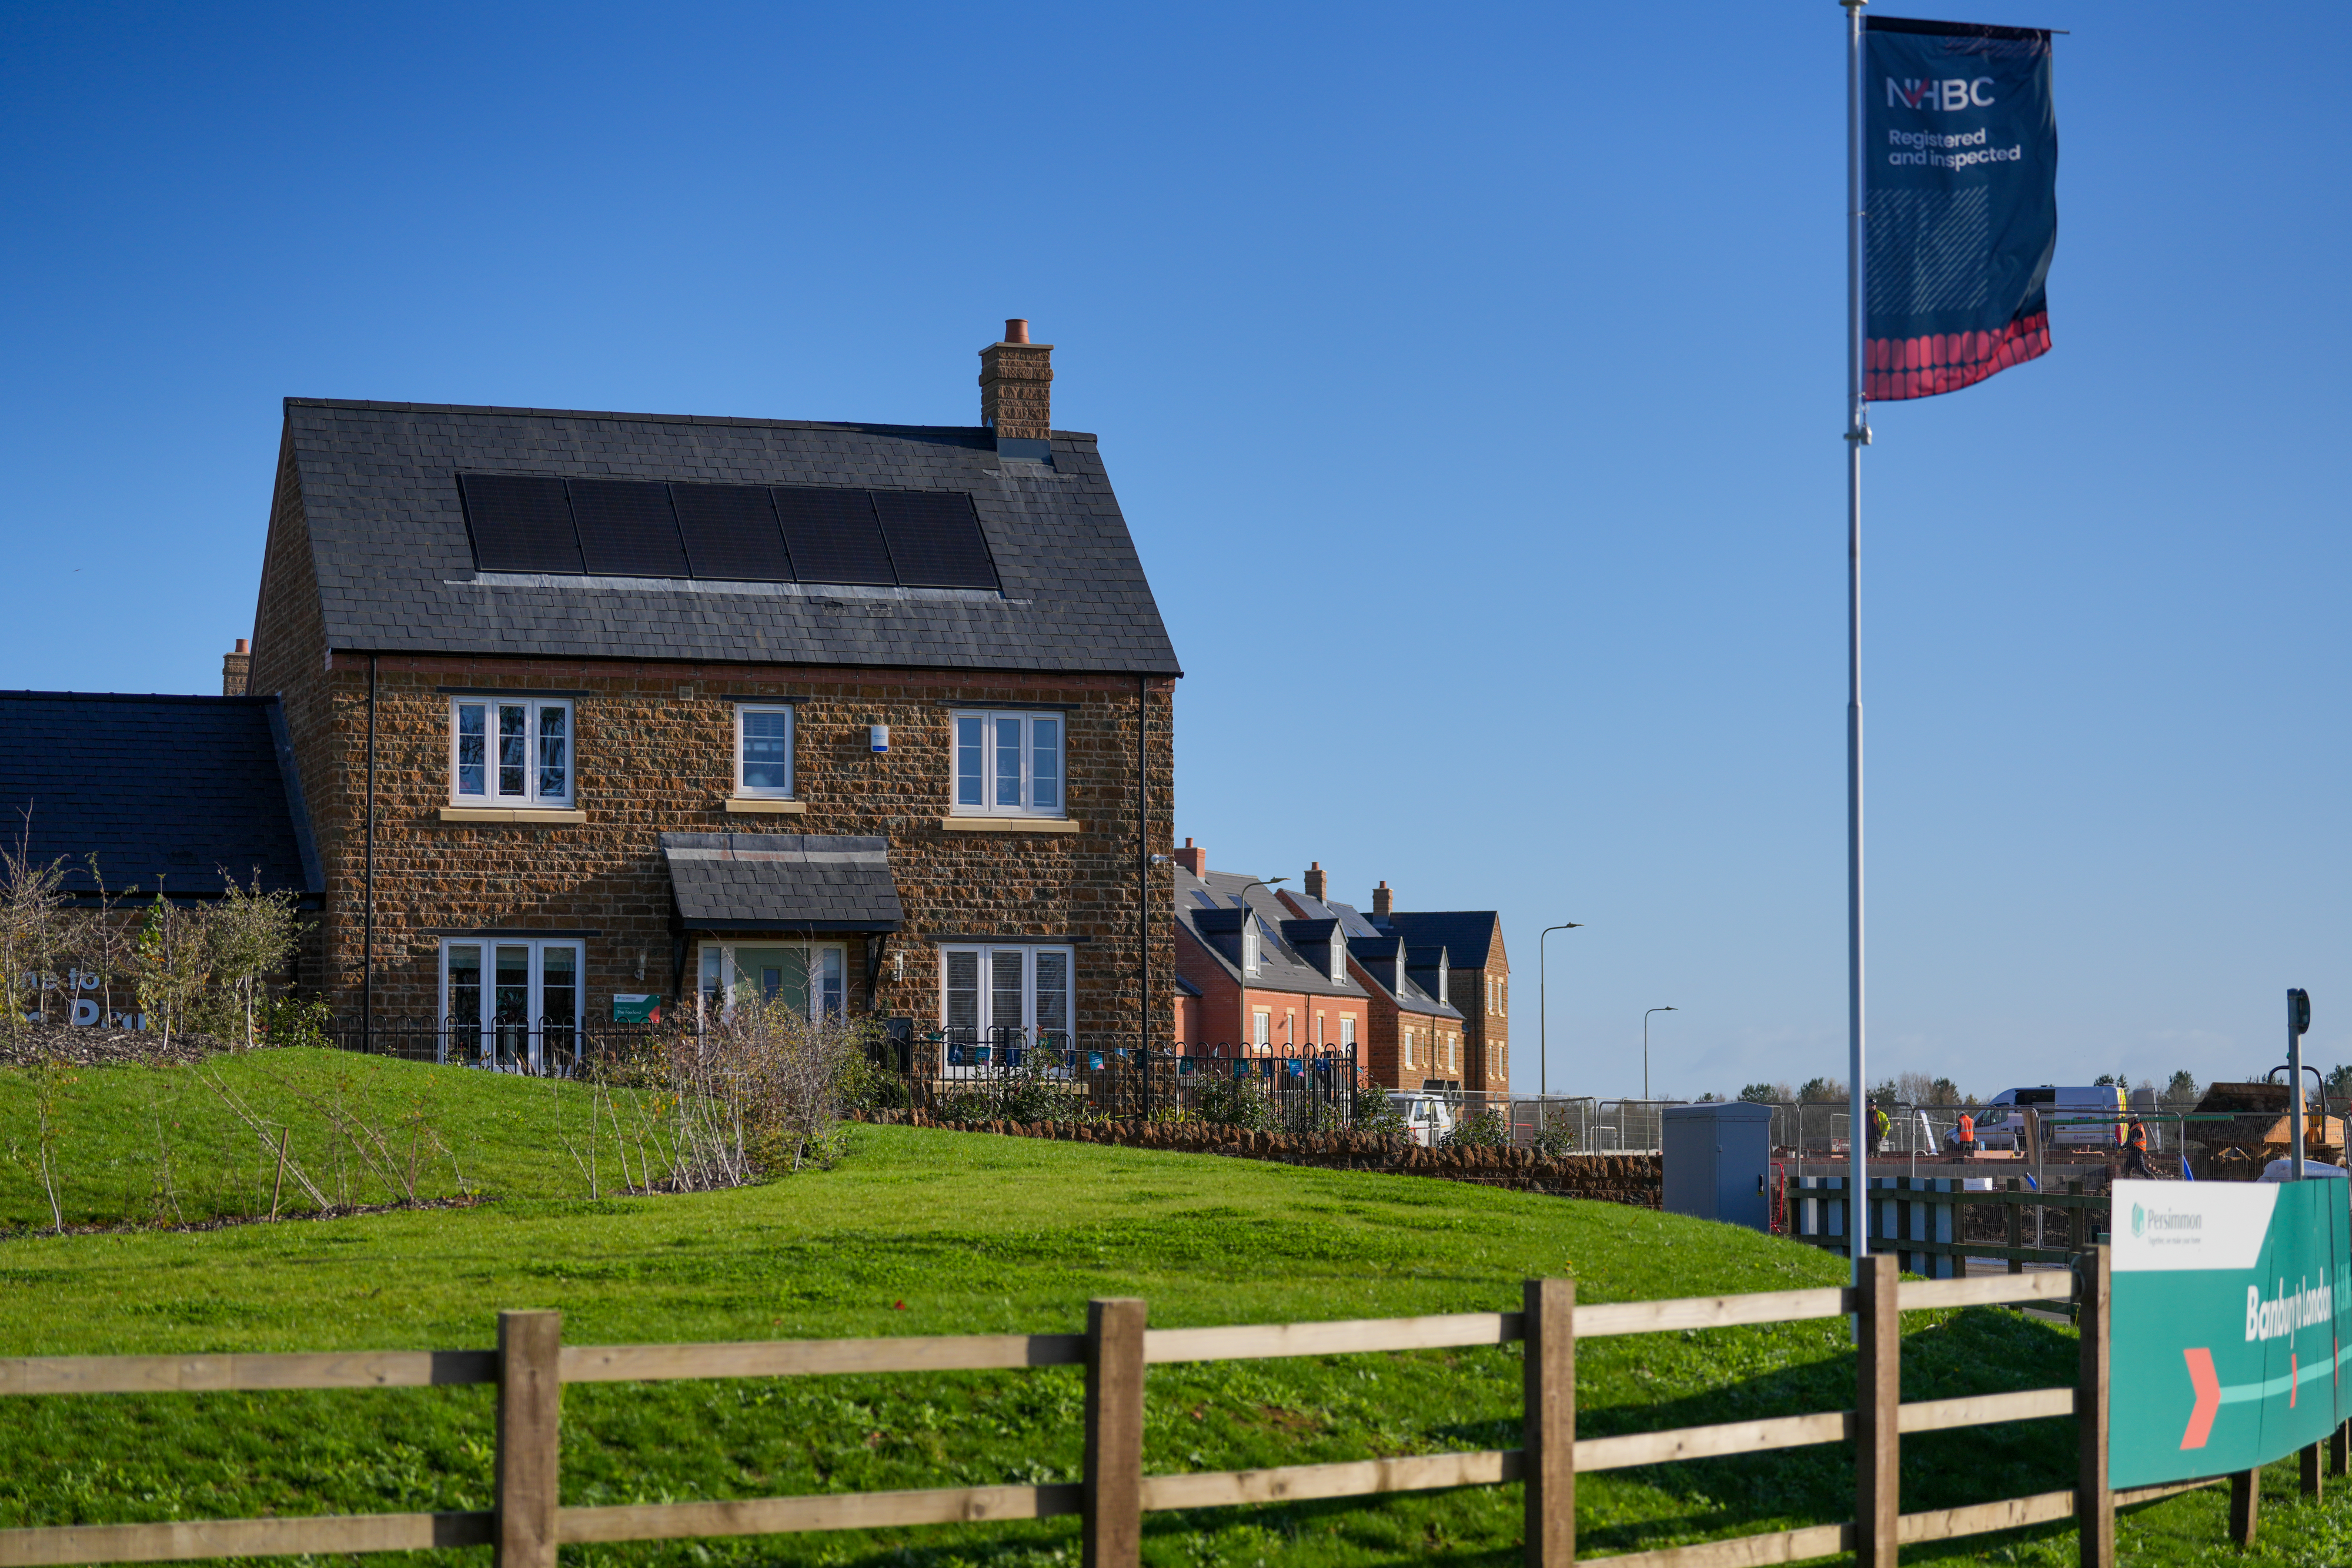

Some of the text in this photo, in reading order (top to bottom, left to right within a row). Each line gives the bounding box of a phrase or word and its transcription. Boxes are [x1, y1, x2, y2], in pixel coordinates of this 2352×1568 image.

[1886, 76, 1996, 112] NHBC
[1889, 127, 1986, 150] Registered
[1888, 144, 2021, 172] and inspected
[2148, 1207, 2202, 1230] Persimmon
[2245, 1276, 2296, 1349] Banbury
[2295, 1283, 2302, 1330] to
[2302, 1266, 2331, 1328] London
